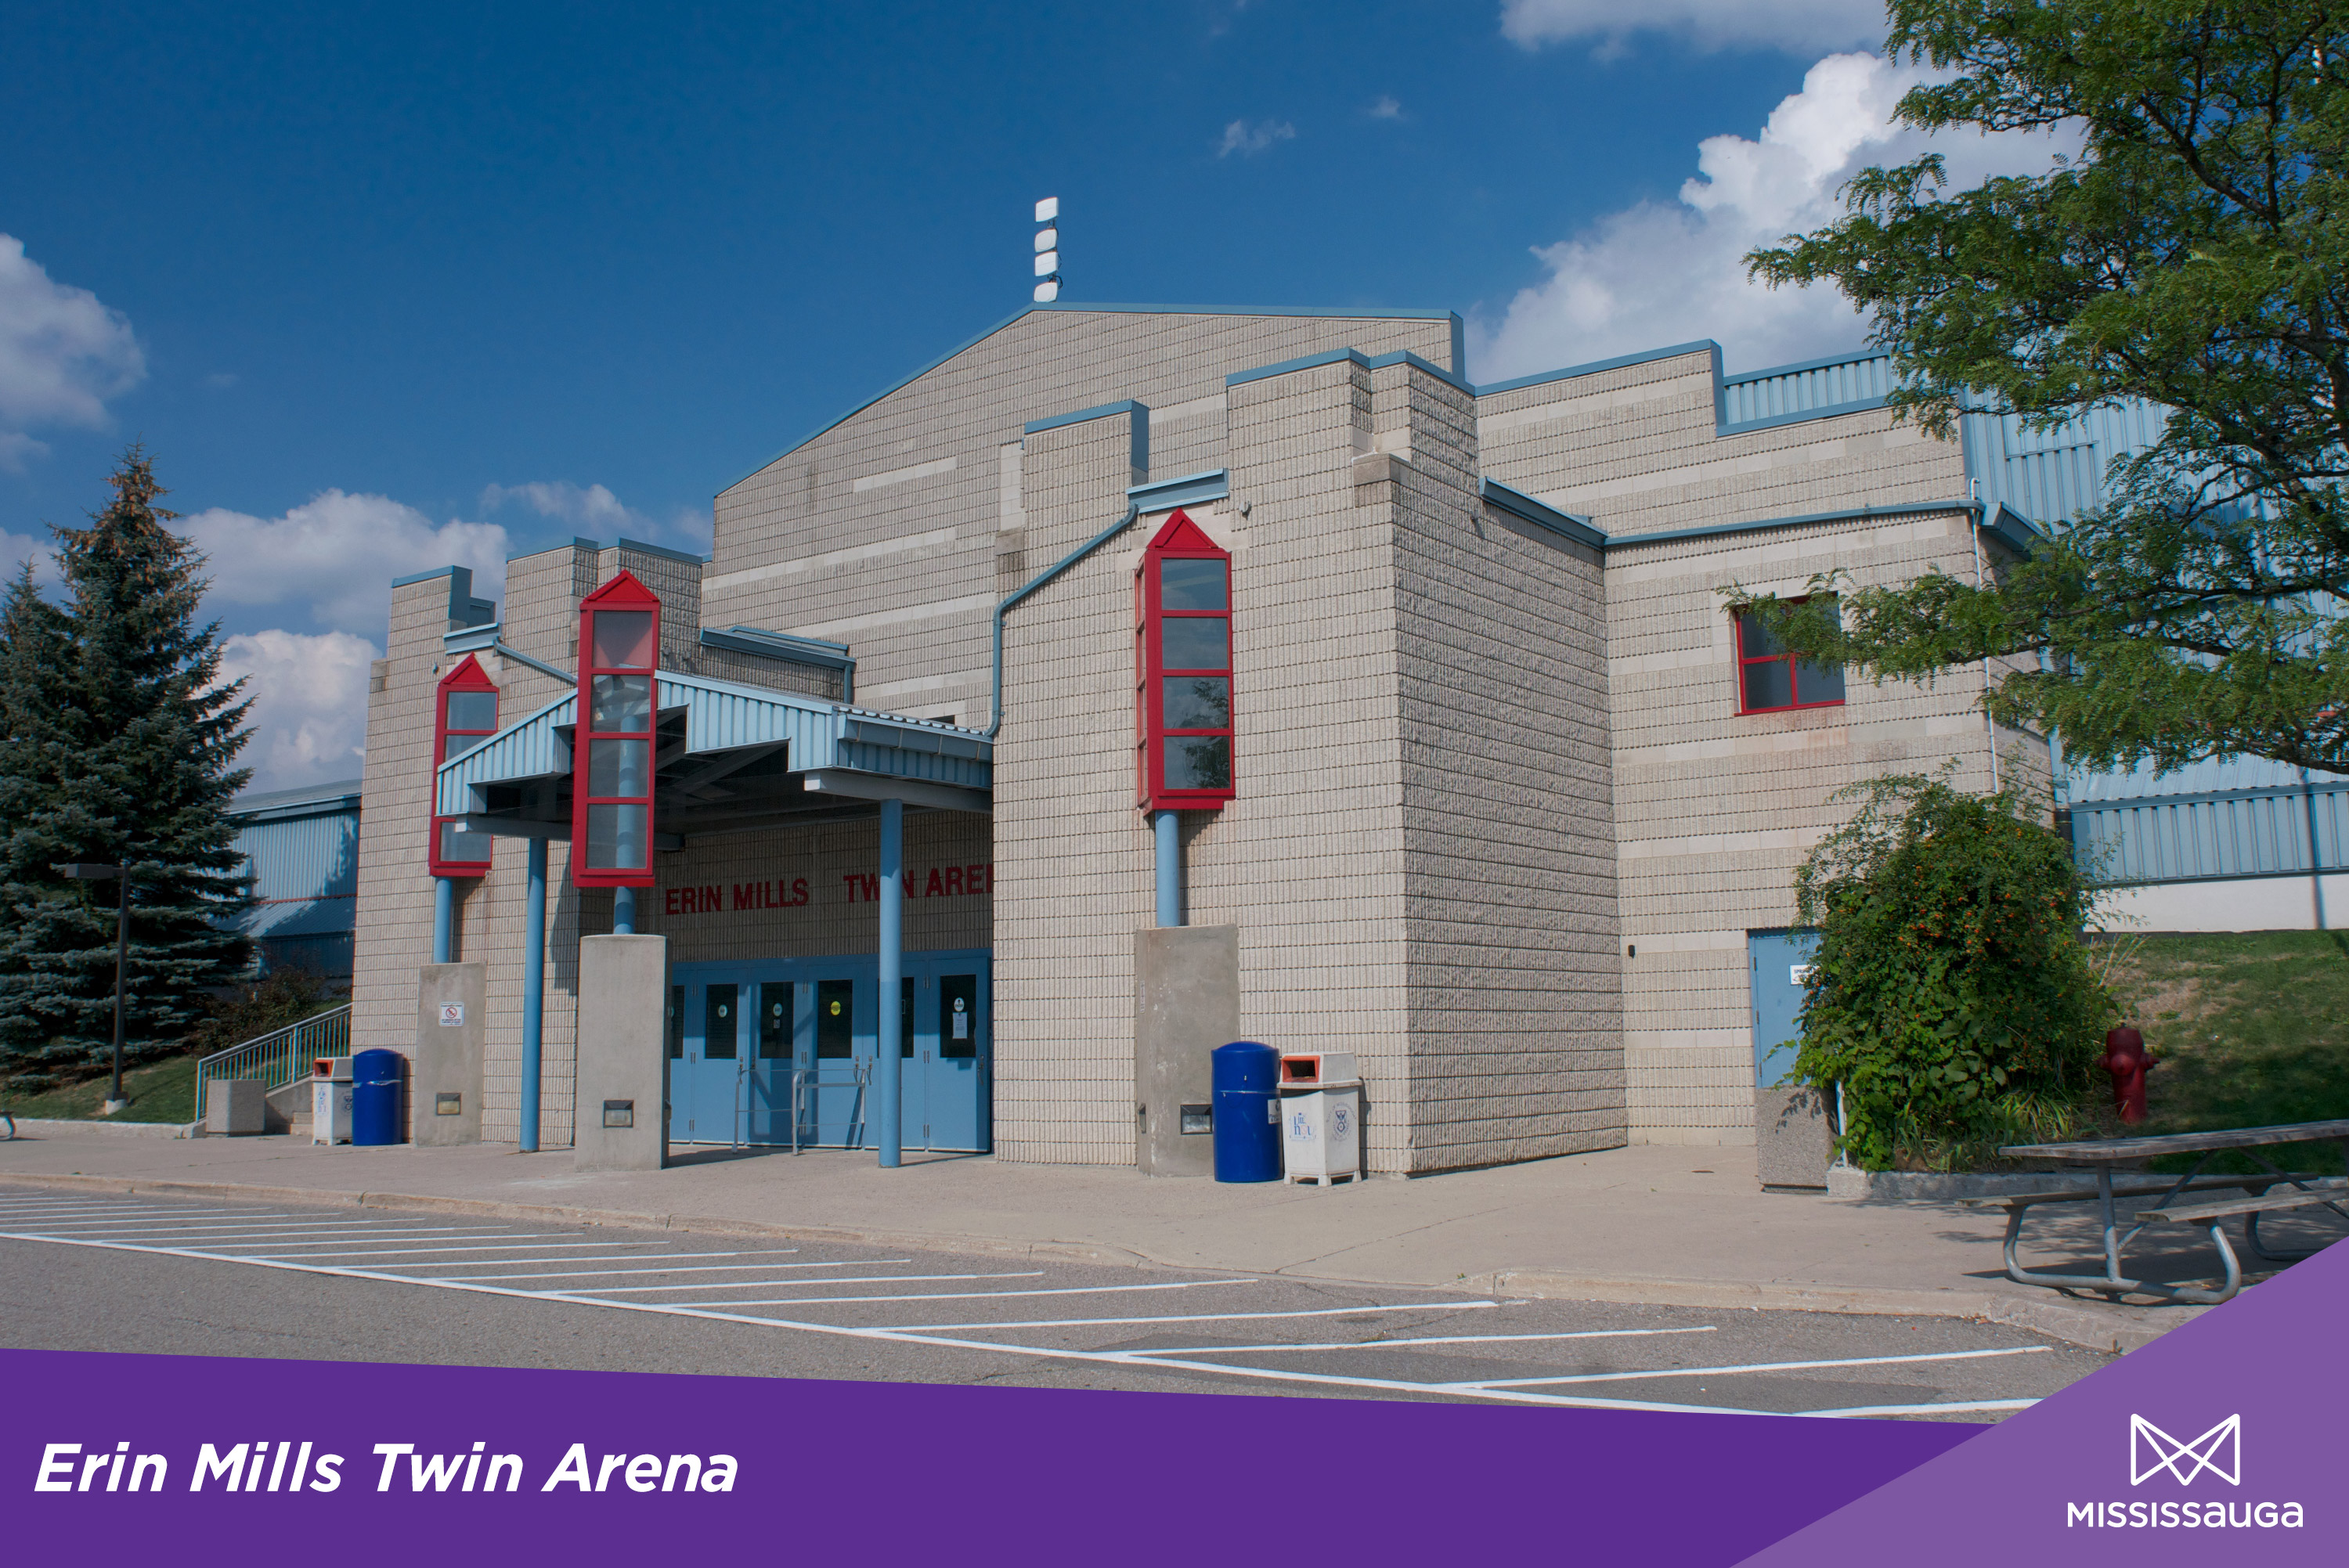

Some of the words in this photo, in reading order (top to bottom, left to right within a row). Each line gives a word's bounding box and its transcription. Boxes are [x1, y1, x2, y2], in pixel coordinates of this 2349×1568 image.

[666, 885, 722, 915] ERIN
[733, 878, 809, 910] MILLS
[843, 869, 915, 903] TWN
[925, 863, 992, 898] ARE
